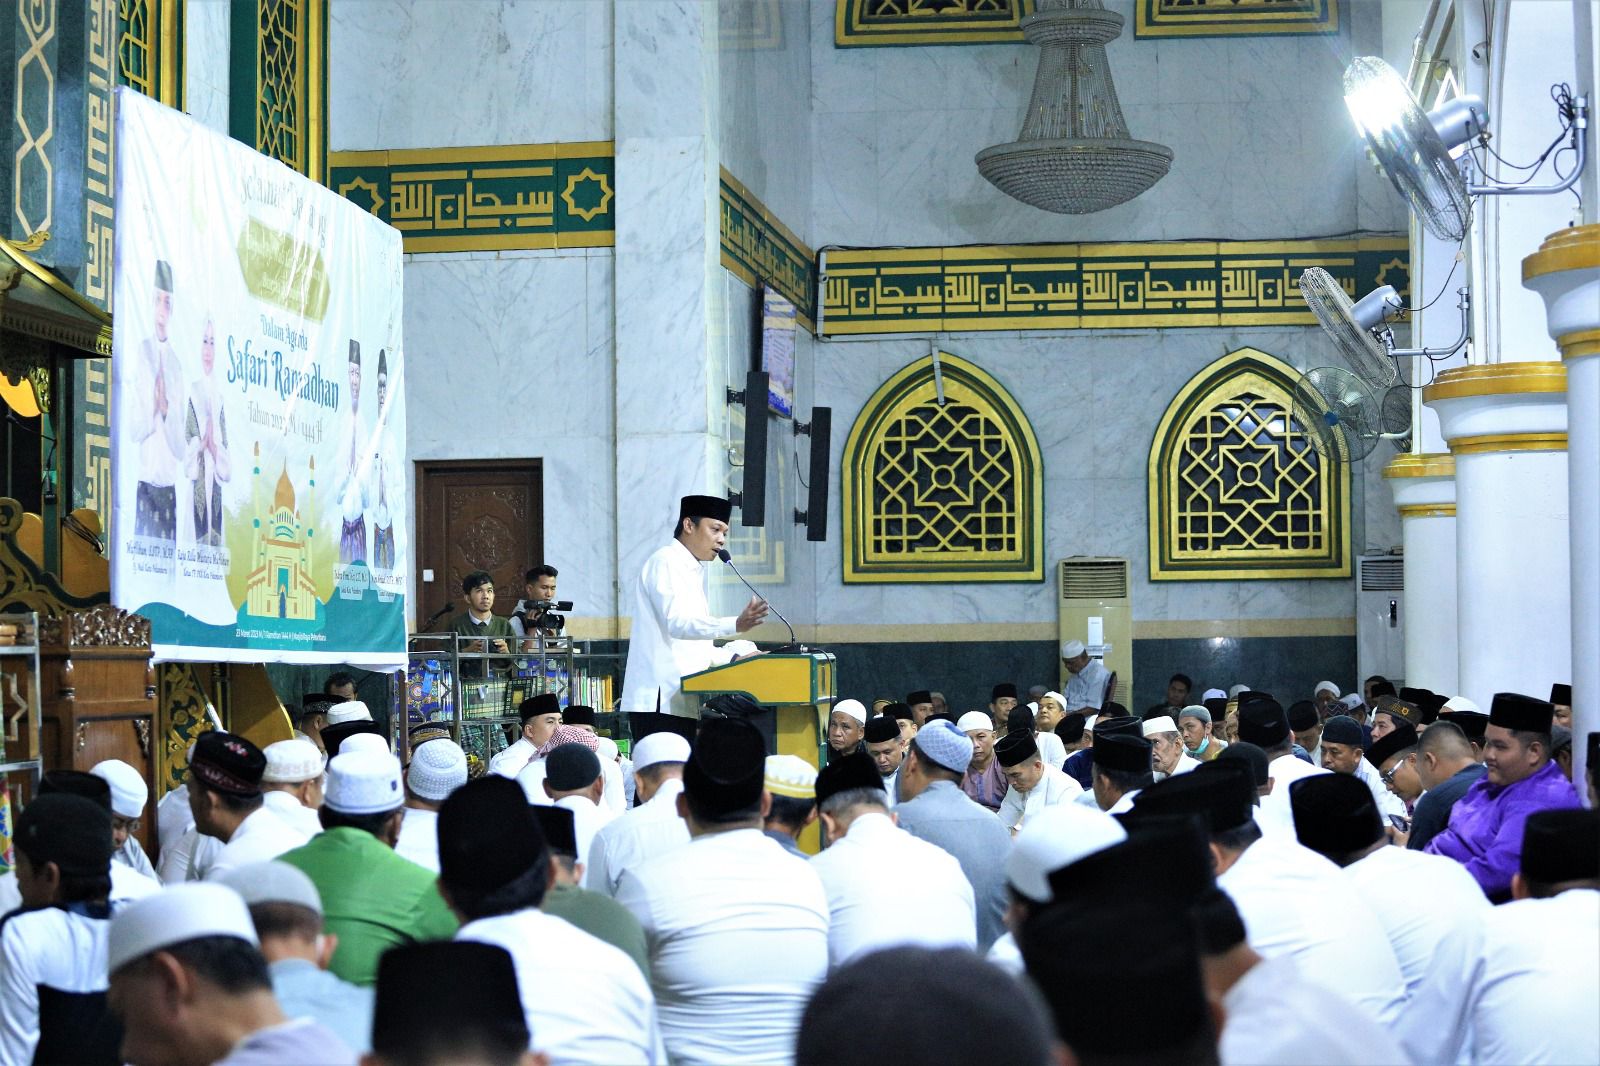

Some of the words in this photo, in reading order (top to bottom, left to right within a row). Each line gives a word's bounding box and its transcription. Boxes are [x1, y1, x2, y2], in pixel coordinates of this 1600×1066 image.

[260, 314, 284, 342] Dalam
[227, 335, 268, 393] Safari
[270, 351, 339, 413] Ramadhan
[247, 401, 270, 428] Tahun
